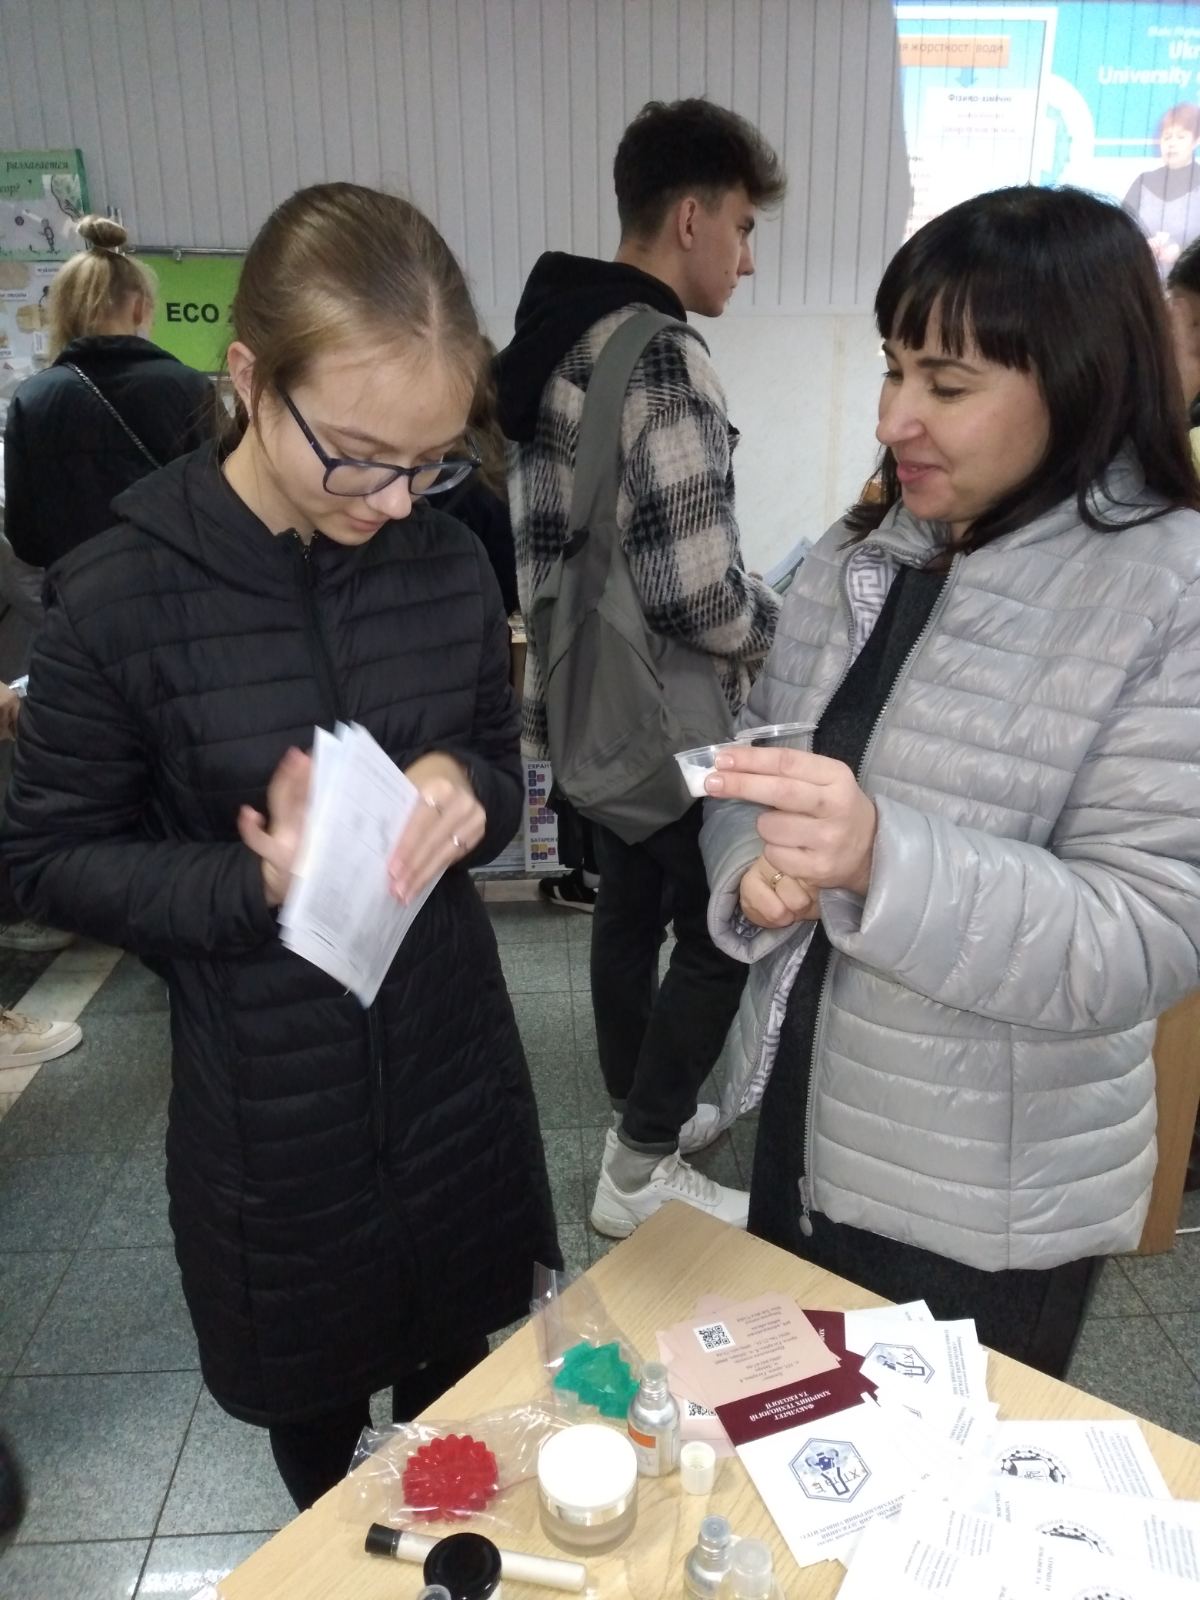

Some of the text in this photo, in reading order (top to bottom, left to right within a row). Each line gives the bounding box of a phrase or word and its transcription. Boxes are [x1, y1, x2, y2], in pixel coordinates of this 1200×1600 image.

[1098, 65, 1193, 88] University
[166, 302, 220, 323] ECO
[774, 1403, 815, 1420] ФАКУЛЬТЕТ
